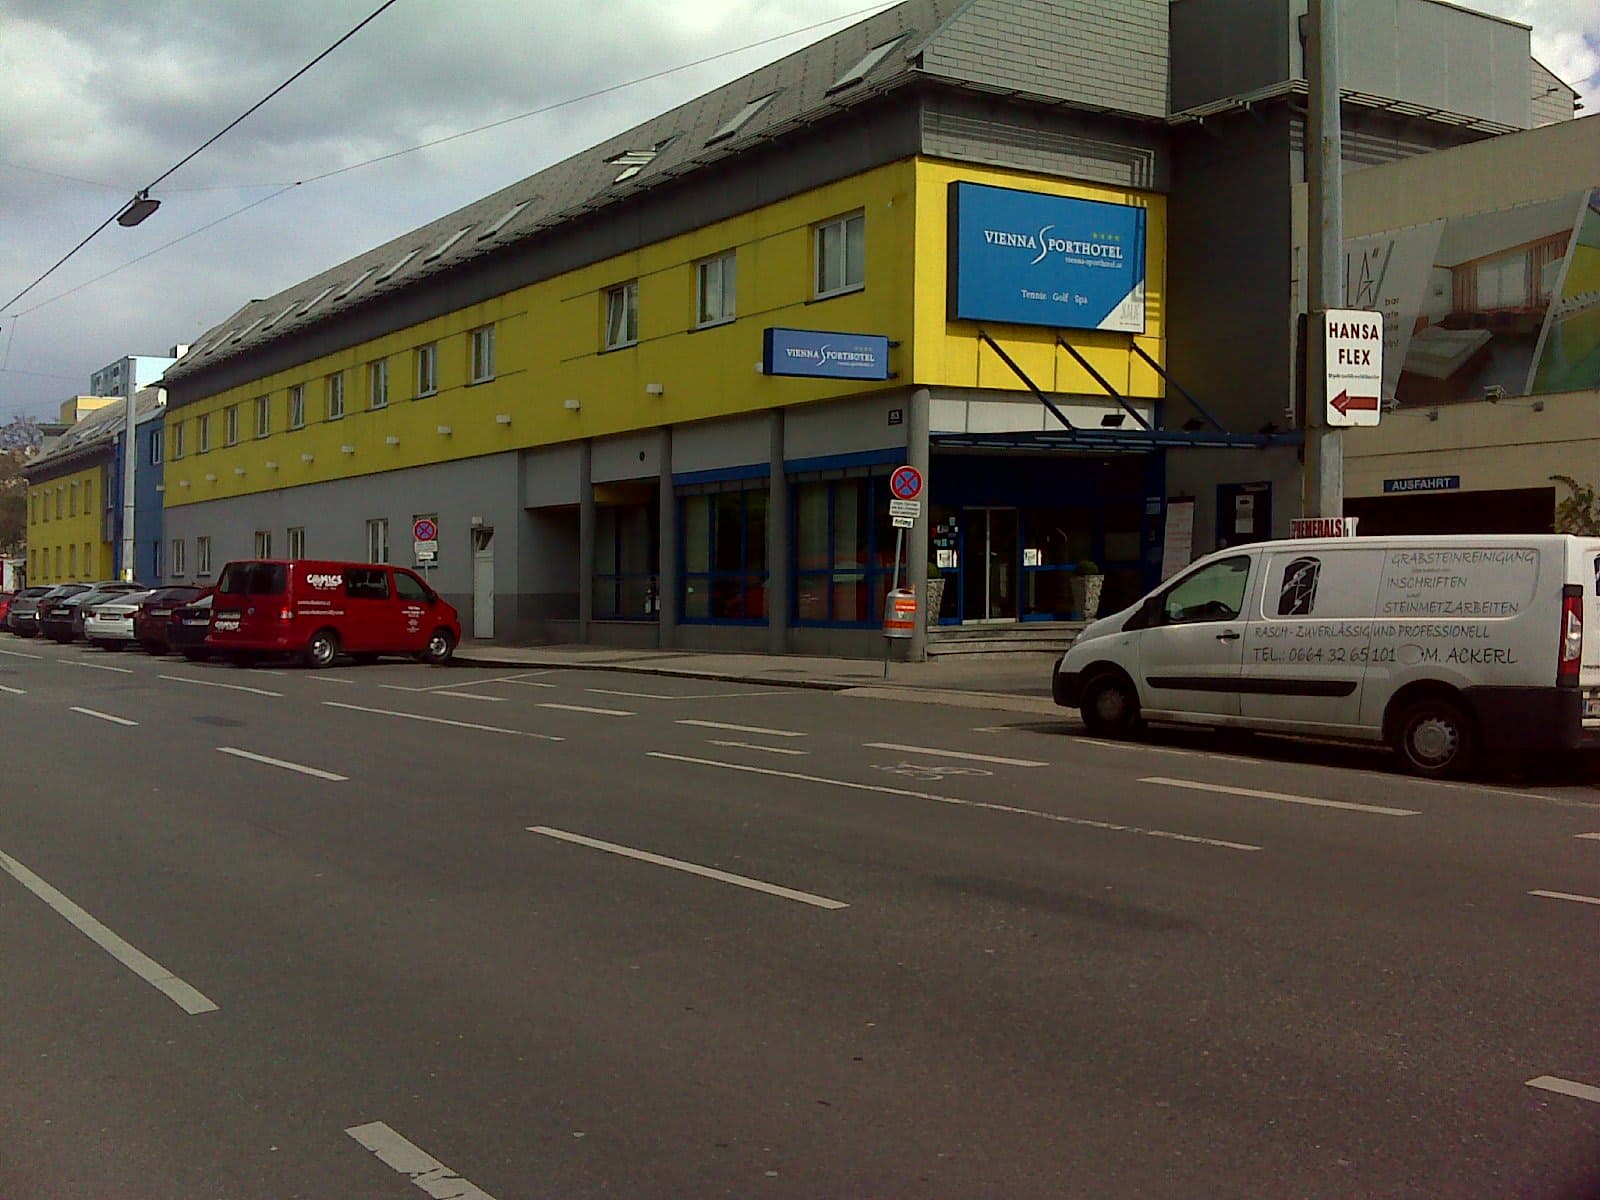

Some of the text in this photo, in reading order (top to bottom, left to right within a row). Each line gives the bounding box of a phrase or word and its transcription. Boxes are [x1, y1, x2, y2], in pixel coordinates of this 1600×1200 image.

[984, 224, 1123, 265] VIENNA SPORTHOTEL
[1021, 289, 1089, 306] Tennis Golf Spa
[1328, 322, 1380, 340] HANSA
[786, 348, 820, 360] VIENNA
[1338, 348, 1371, 366] FLEX
[1391, 478, 1452, 491] AUSFAHRT
[1391, 551, 1535, 567] GRABSTEINREINIGUNG
[1386, 575, 1468, 589] INSCHRIFTEN
[1382, 601, 1520, 614] STEINMETZARBEITEN
[1373, 625, 1396, 638] UND
[1398, 624, 1490, 639] PROFESSIONELL
[1288, 647, 1323, 662] 0664
[1328, 647, 1346, 662] 32
[1350, 646, 1369, 662] 65
[1371, 647, 1397, 662] 101
[1445, 647, 1519, 664] ACKERL
